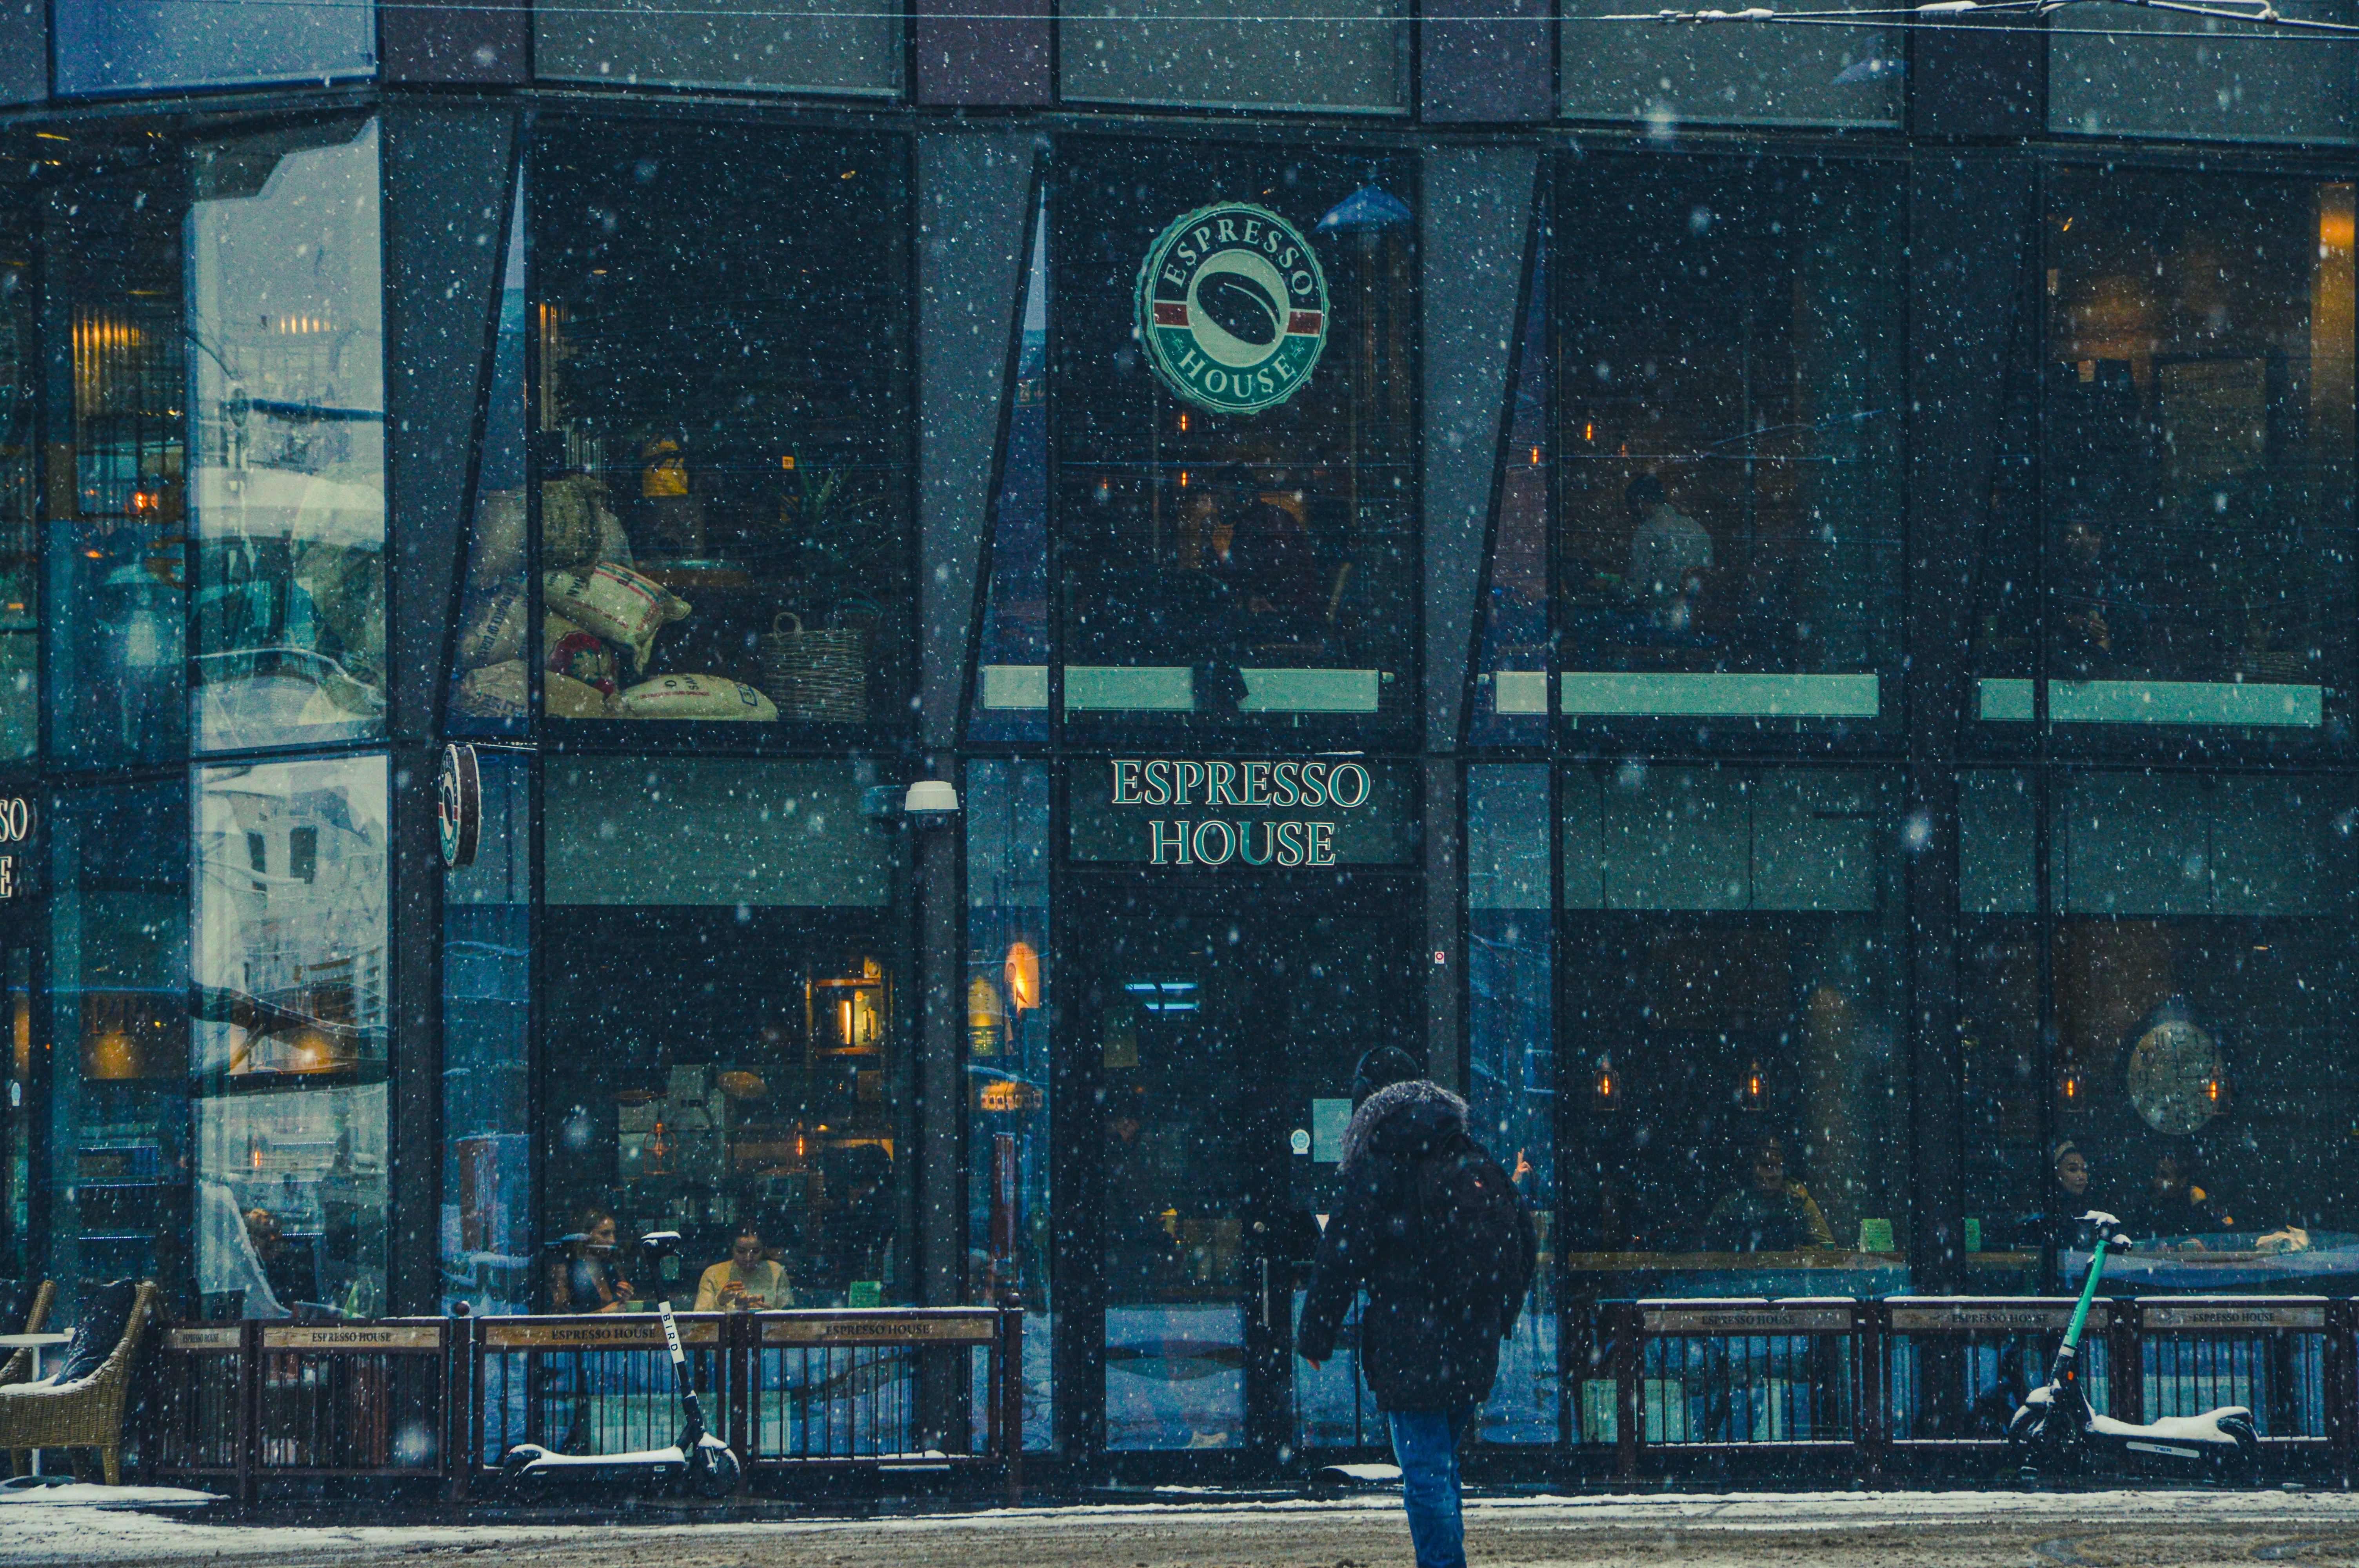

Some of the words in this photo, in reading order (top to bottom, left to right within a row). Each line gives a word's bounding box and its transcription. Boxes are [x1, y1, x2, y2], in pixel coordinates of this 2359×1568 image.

[1163, 218, 1313, 295] ESPRESSO
[1178, 349, 1296, 398] HOUSE
[1111, 760, 1370, 808] ESPRESSO
[1149, 820, 1336, 866] HOUSE
[1701, 1315, 1754, 1325] ESPRESSO
[1757, 1314, 1795, 1324] HOUSE
[1952, 1314, 2006, 1323] ESPRESSO
[2193, 1313, 2240, 1322] ESPRESSO
[2242, 1312, 2275, 1322] HOUSE
[552, 1329, 611, 1340] ESPRESSO
[614, 1328, 656, 1338] HOUSE
[663, 1313, 678, 1352] BIRD
[825, 1325, 885, 1334] ESPRESSO
[888, 1324, 931, 1334] HOUSE
[183, 1334, 204, 1343] ESPRESSO
[204, 1333, 218, 1342] HOUSE
[312, 1332, 357, 1342] ESPRESSO
[359, 1332, 391, 1342] HOUSE
